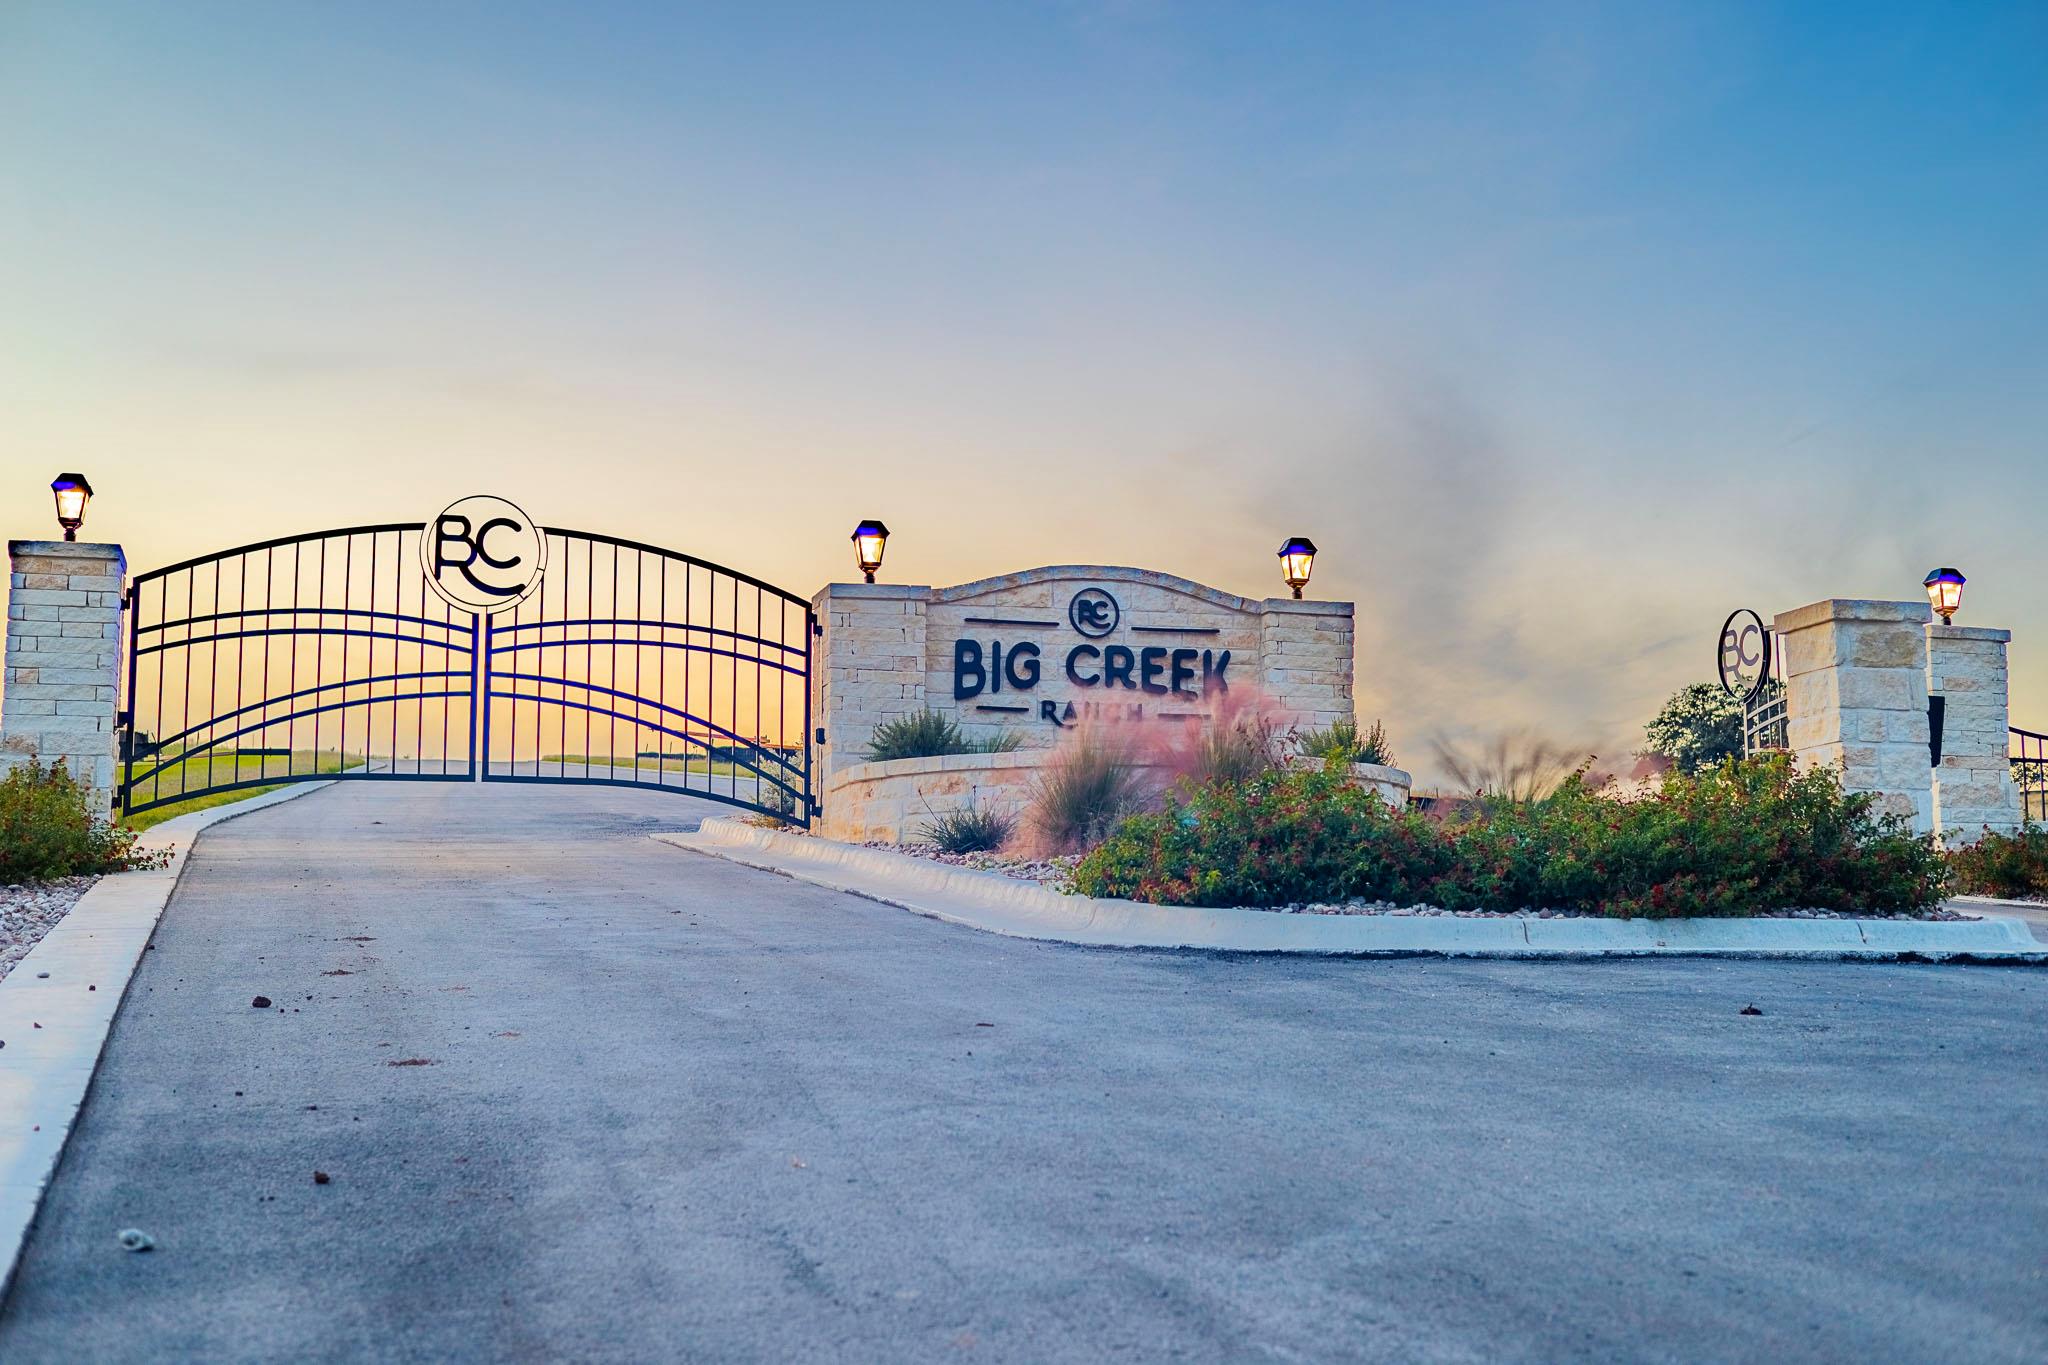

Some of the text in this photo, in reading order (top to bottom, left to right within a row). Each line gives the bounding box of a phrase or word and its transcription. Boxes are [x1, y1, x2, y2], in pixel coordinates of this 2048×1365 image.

[954, 639, 1232, 701] BIG CREEK
[1041, 700, 1143, 729] RANH
